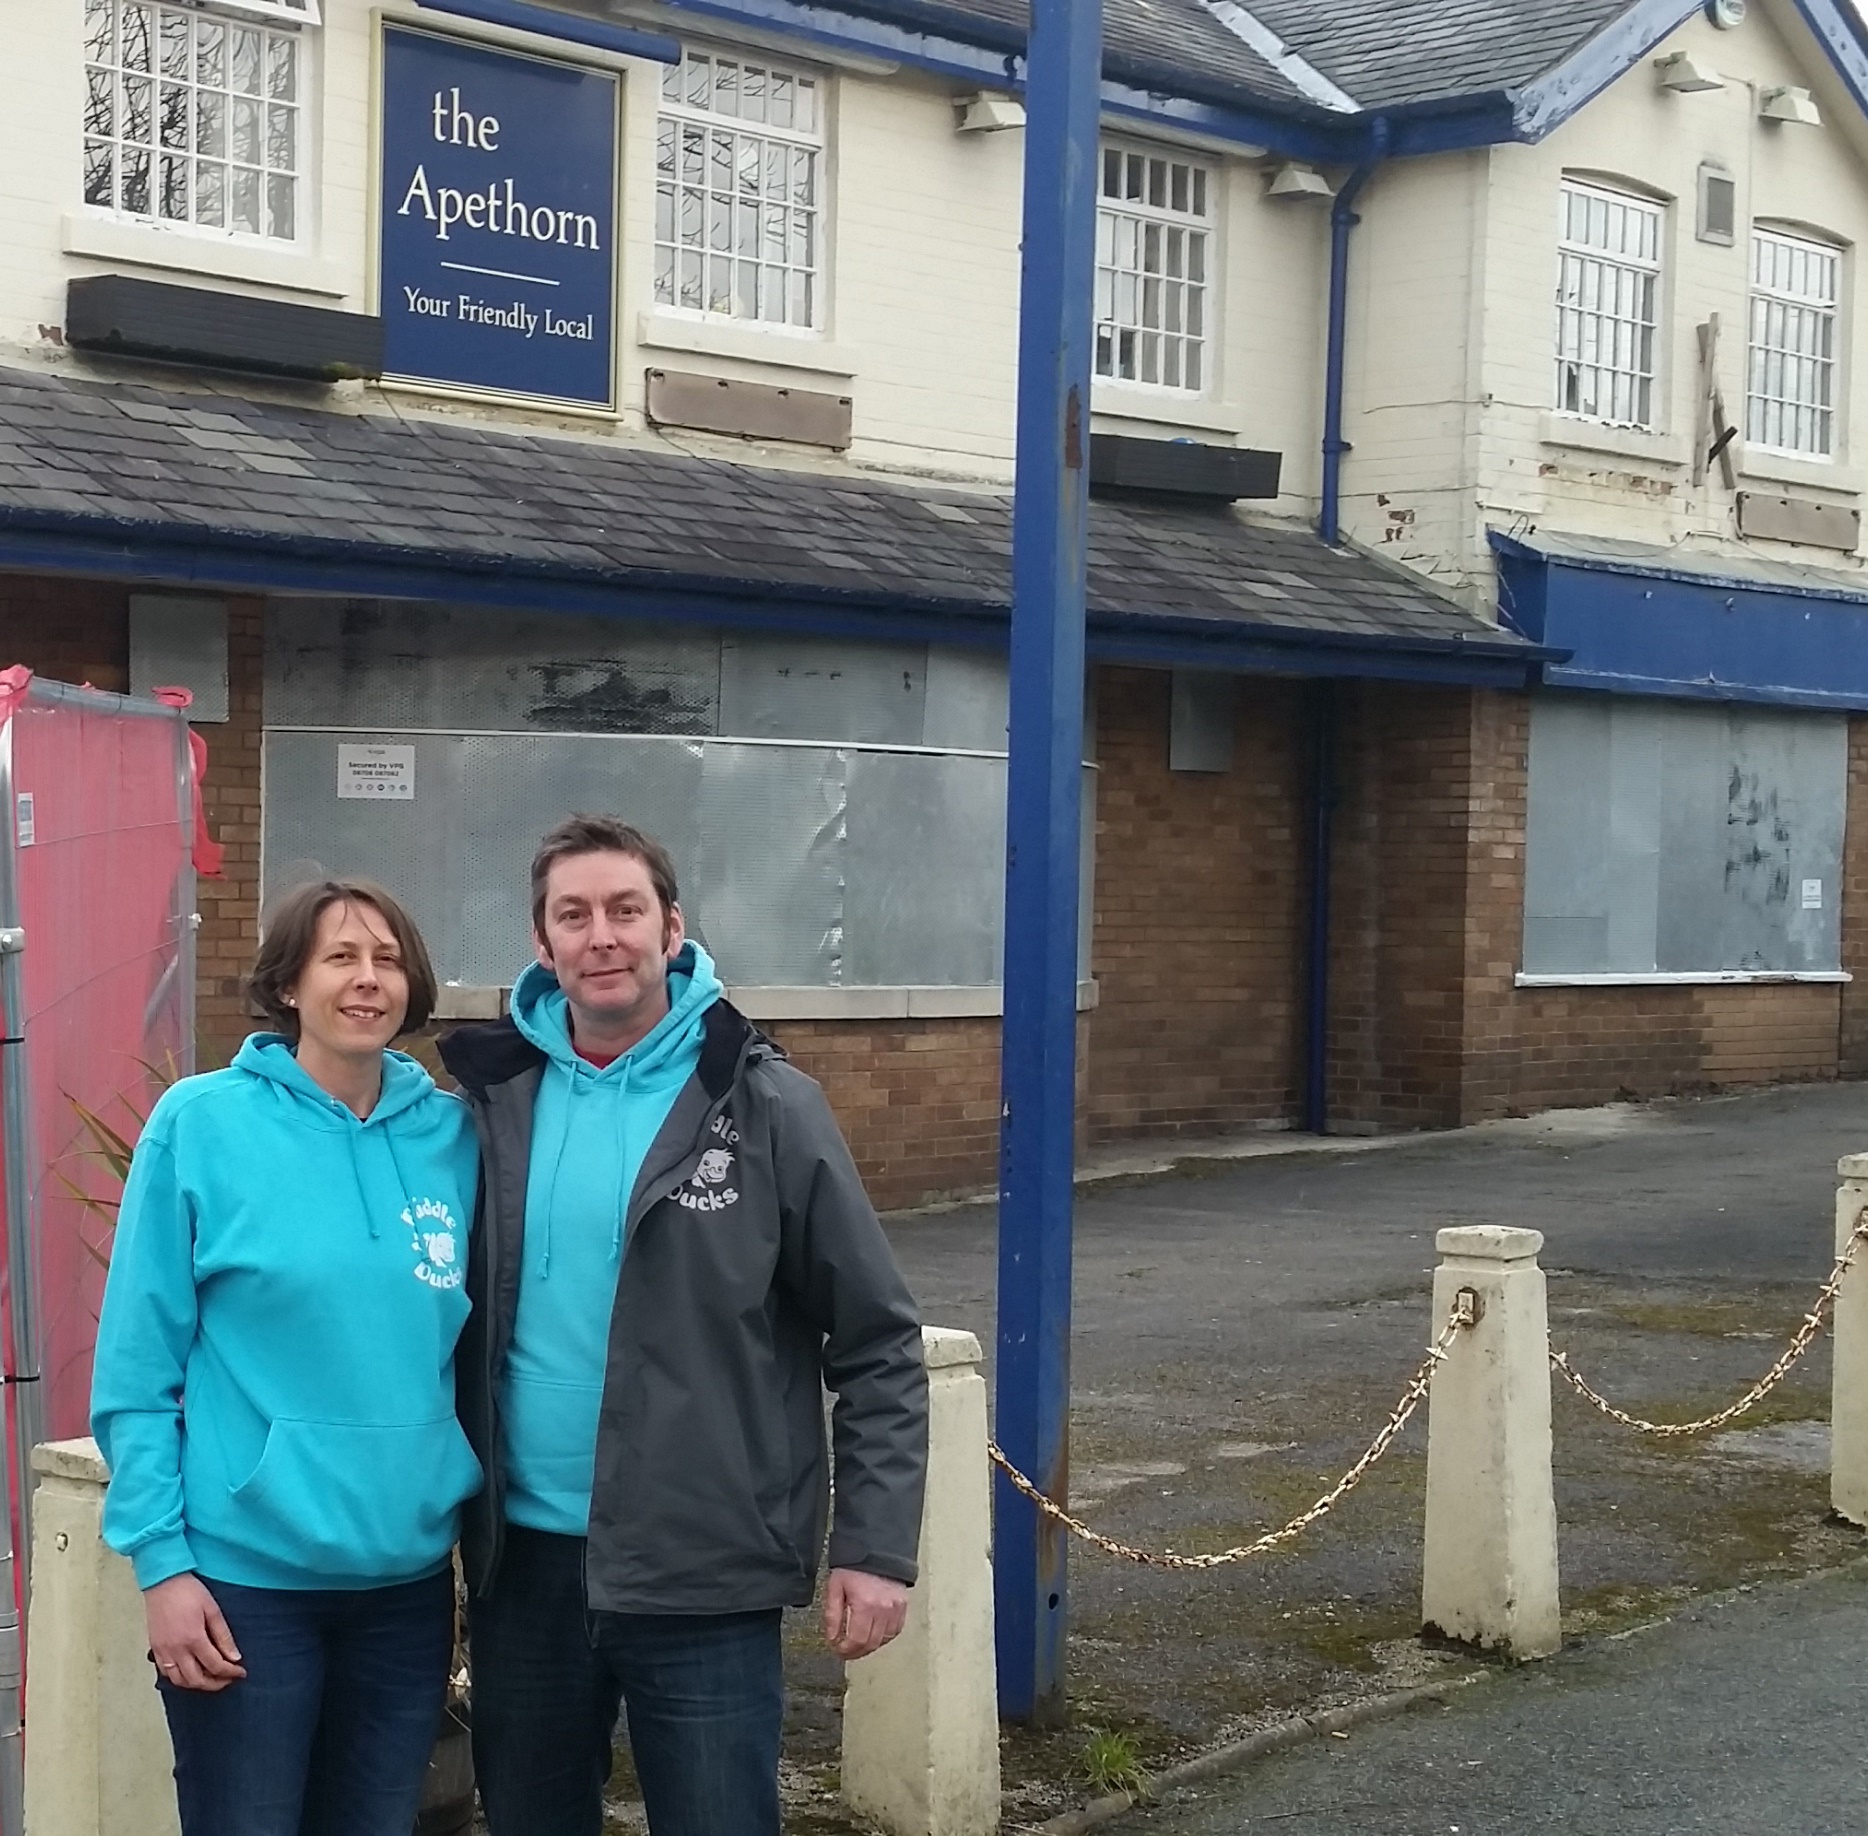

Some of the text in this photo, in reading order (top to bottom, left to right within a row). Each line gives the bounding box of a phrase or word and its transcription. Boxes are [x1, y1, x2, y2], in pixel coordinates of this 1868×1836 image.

[432, 87, 500, 152] the
[397, 164, 601, 251] Apethorn
[403, 285, 594, 341] Your Friendly Local
[348, 761, 405, 770] Secured by VPS
[710, 1114, 740, 1146] dle
